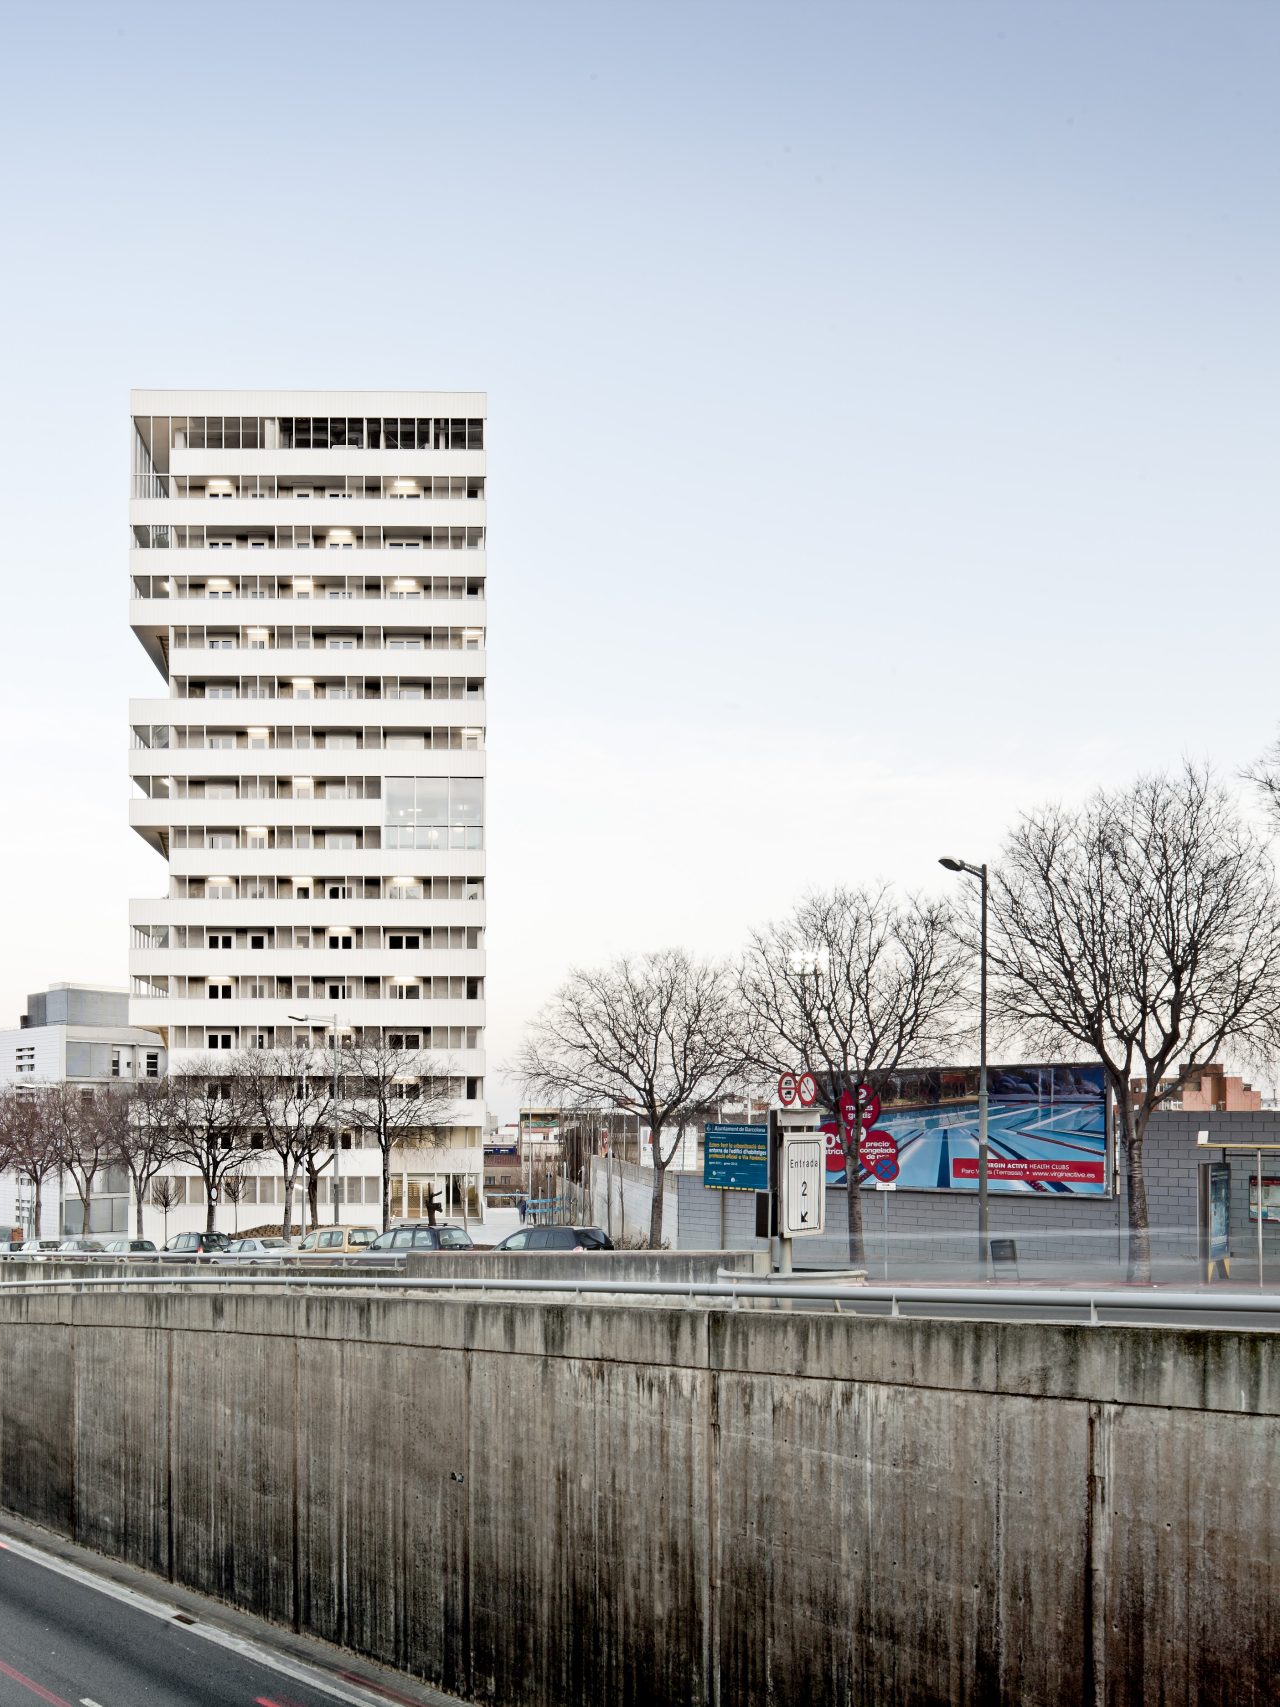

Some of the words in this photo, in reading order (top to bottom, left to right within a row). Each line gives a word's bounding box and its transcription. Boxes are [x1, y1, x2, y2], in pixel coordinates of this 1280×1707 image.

[865, 1141, 890, 1149] precio
[859, 1147, 896, 1155] congelado
[790, 1159, 819, 1169] Entrada
[993, 1169, 1024, 1177] (Terrassa)
[1032, 1170, 1096, 1179] www.virginactive.es
[801, 1181, 808, 1197] 2
